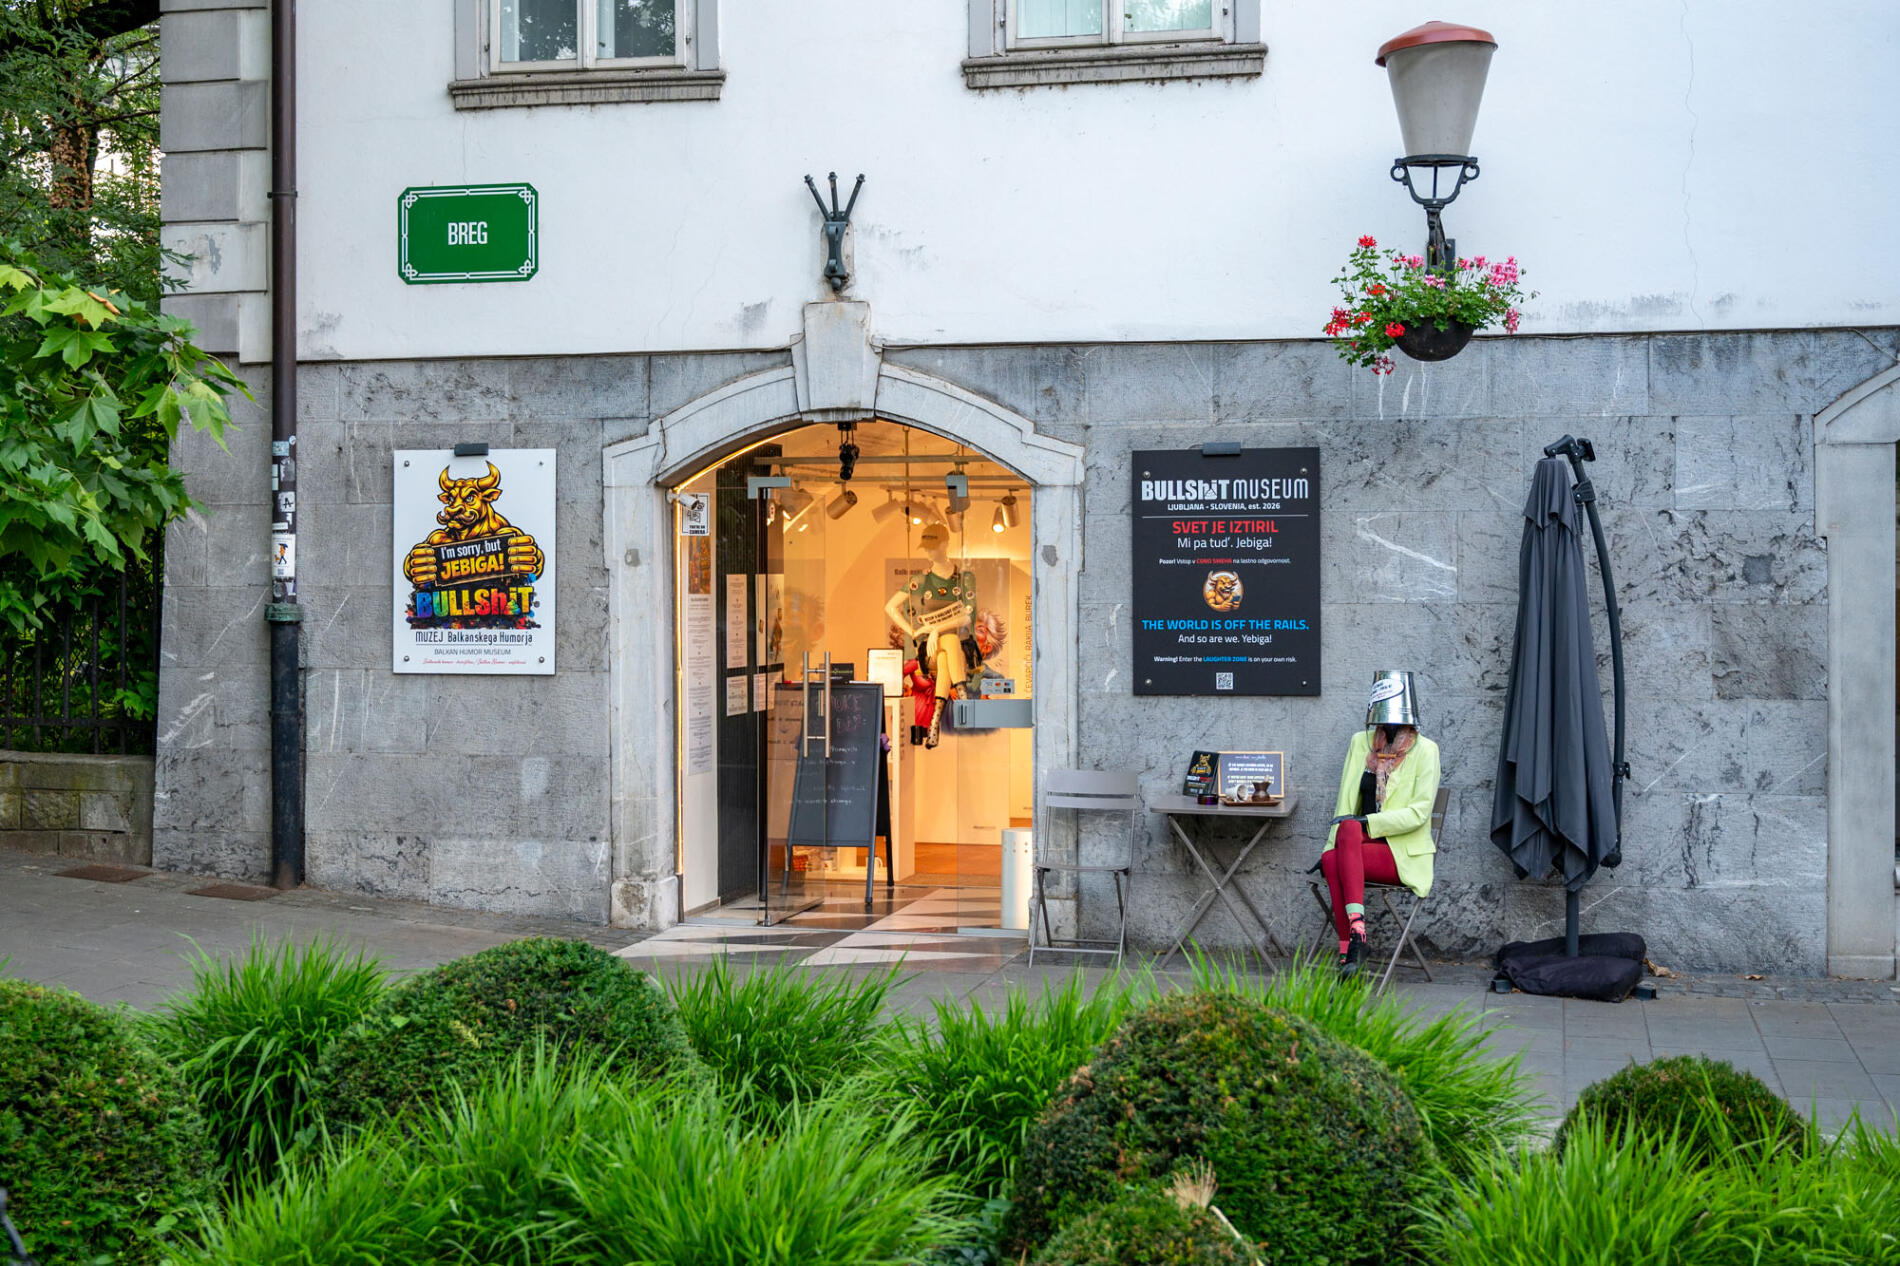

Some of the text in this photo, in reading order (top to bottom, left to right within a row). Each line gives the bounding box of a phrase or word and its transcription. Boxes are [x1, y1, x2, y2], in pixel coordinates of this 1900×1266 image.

[448, 221, 488, 245] BREG
[1233, 478, 1308, 499] MUSEUM
[1262, 502, 1280, 510] 2026
[1172, 520, 1279, 534] SVET JE IZTIRIL
[440, 546, 456, 559] I'm
[485, 539, 502, 552] but
[1177, 537, 1191, 548] Mi
[1193, 539, 1207, 551] pa
[1236, 536, 1272, 551] Jebiga!
[440, 552, 505, 580] JEBIGA!
[1142, 619, 1310, 630] THE WORLD IS OFF THE RAILS.
[415, 631, 533, 646] MUZEJ Balkanskega Humorja
[1178, 634, 1195, 643] And
[1242, 634, 1272, 645] Yebiga!
